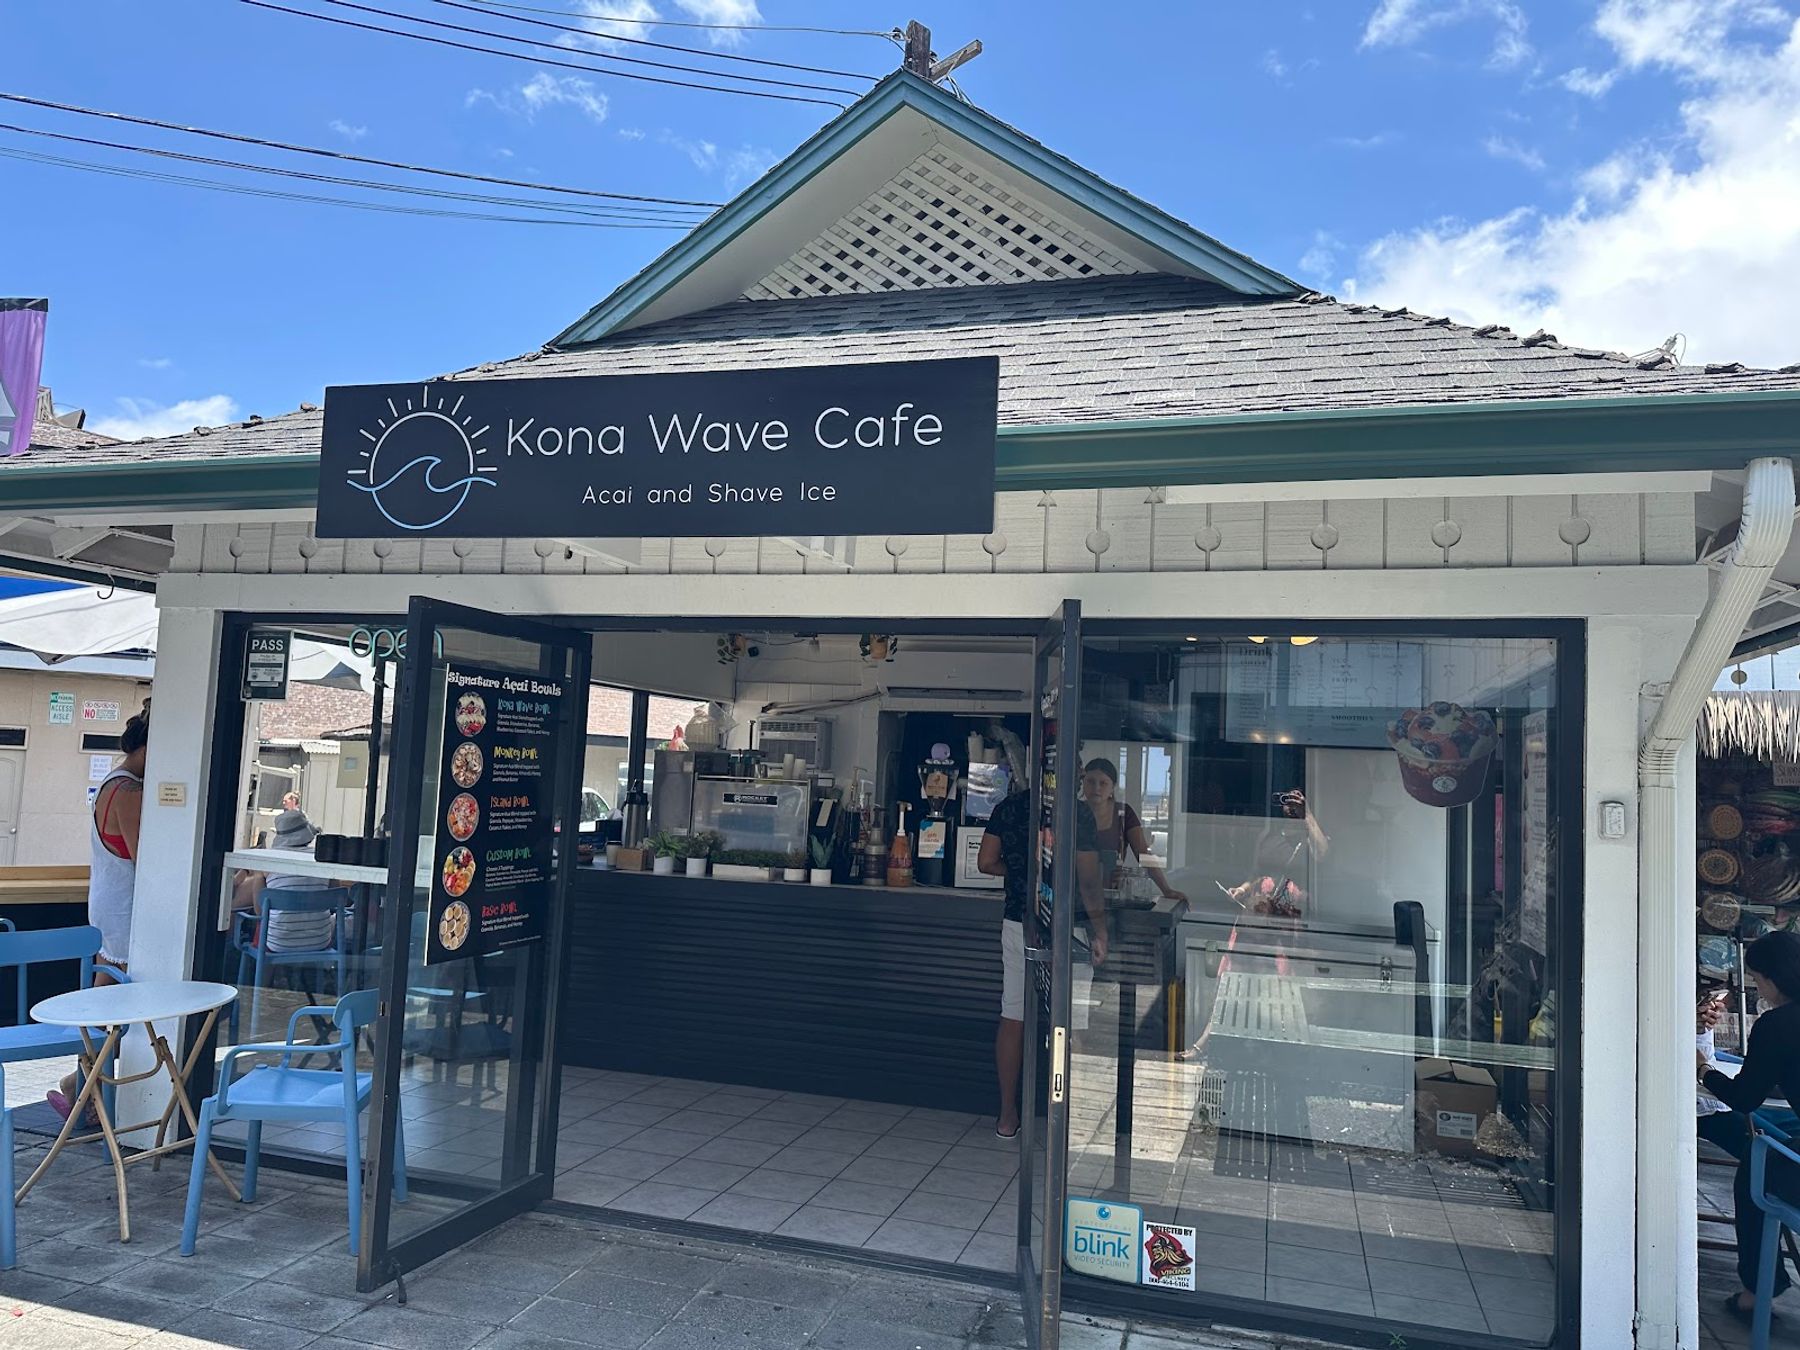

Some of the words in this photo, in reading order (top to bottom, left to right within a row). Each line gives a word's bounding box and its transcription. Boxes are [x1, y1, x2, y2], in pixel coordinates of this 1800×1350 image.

[508, 418, 624, 456] Kona
[649, 413, 788, 453] Wave
[815, 403, 942, 448] Cafe
[582, 486, 631, 503] Acai
[648, 484, 691, 503] and
[709, 483, 782, 502] Shave
[801, 482, 835, 500] Ice
[251, 639, 284, 651] PASS
[448, 671, 500, 688] Signature
[531, 681, 562, 697] Bowls
[84, 708, 95, 718] NO
[1146, 1224, 1183, 1236] PROTECTED
[1184, 1228, 1193, 1236] BY
[1074, 1231, 1129, 1260] blink
[1073, 1254, 1096, 1264] VIDEO
[1097, 1257, 1130, 1268] SECURITY
[1160, 1267, 1191, 1277] VIKING
